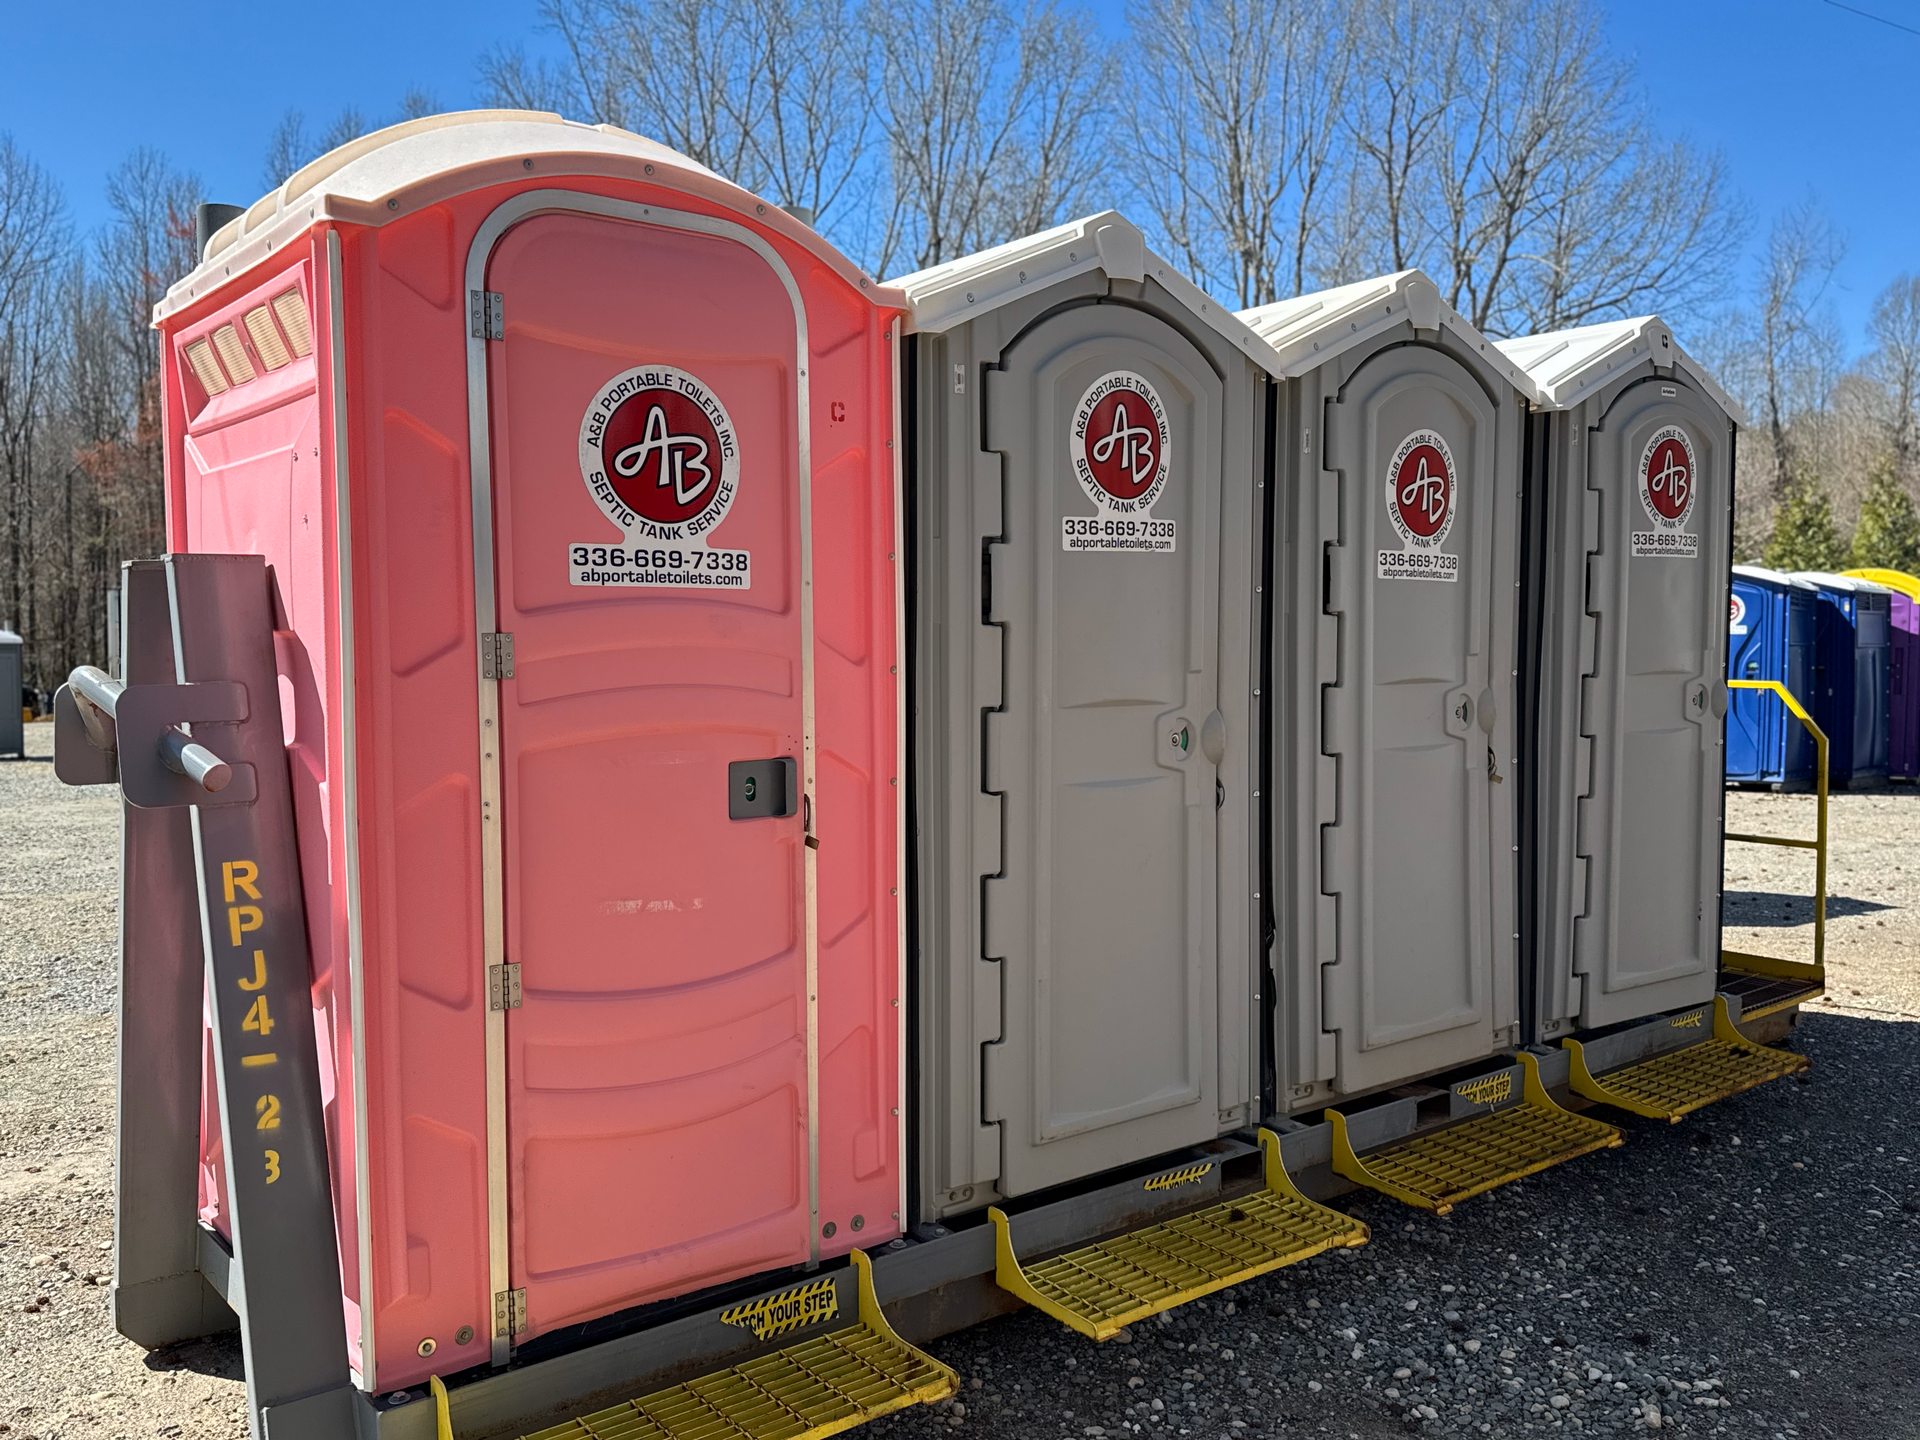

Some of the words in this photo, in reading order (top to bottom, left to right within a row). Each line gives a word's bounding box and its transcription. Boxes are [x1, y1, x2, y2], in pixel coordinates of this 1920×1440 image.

[587, 411, 606, 448] A&B
[601, 372, 673, 412] PORTABLE
[678, 377, 724, 427] TOILETS
[719, 429, 734, 461] INC.
[1075, 410, 1089, 439] A&B
[1085, 377, 1132, 410] PORTABLE
[1135, 379, 1162, 420] TOILETS
[1159, 421, 1168, 448] INC.
[1389, 462, 1400, 486] A&B
[1397, 434, 1432, 461] PORTABLE
[1433, 437, 1452, 470] TOILETS
[1076, 458, 1105, 503] SEPTIC
[1108, 497, 1136, 513] TANK
[1139, 464, 1167, 510] SERVICE
[590, 471, 635, 527] SEPTIC
[639, 520, 684, 540] TANK
[687, 480, 733, 536] SERVICE
[1065, 519, 1174, 538] 336-669-7338
[1389, 501, 1410, 539] SEPTIC
[1411, 534, 1431, 548] TANK
[1433, 508, 1454, 546] SERVICE
[1070, 537, 1171, 550] abportabletoilets.com
[573, 547, 748, 571] 336-669-7338
[1379, 552, 1457, 569] 336-669-7338
[1383, 567, 1455, 579] abportabletoilets.com
[581, 568, 742, 586] abportabletoilets.com
[1479, 1085, 1494, 1100] YOUR
[1495, 1079, 1510, 1095] STEP
[768, 1300, 801, 1324] YOUR
[804, 1289, 834, 1314] STEP
